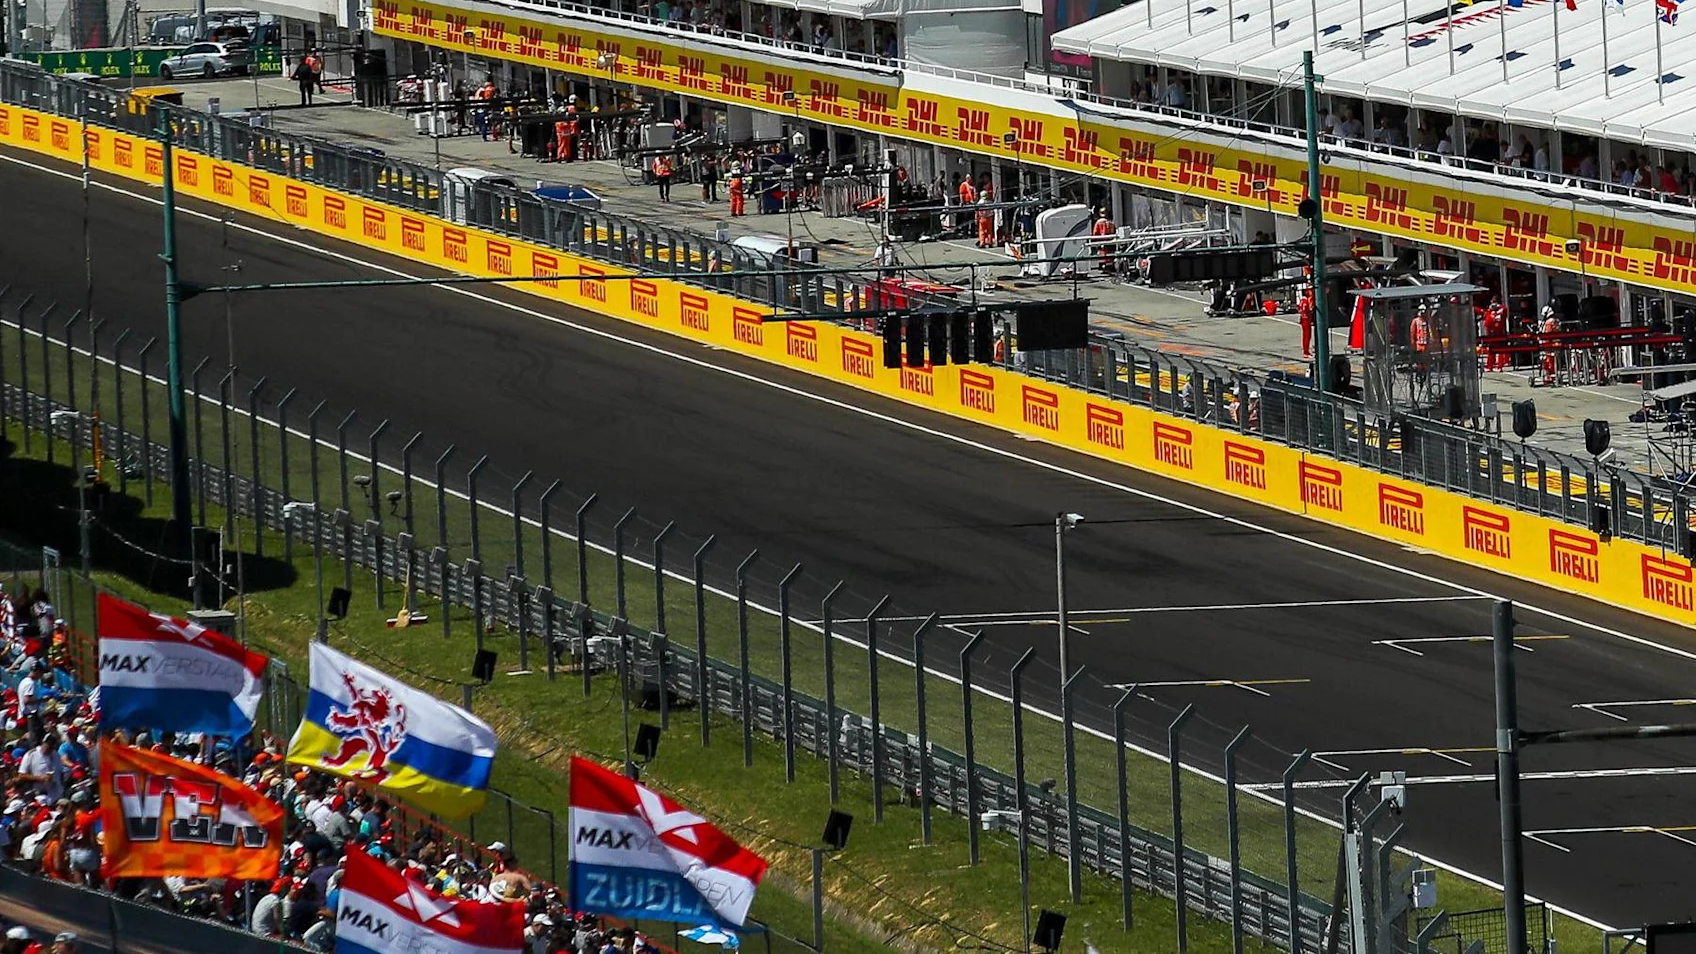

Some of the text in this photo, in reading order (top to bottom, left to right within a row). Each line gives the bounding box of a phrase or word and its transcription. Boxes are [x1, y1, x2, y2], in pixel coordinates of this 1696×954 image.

[377, 0, 398, 30] DHL
[412, 7, 432, 37] DHL
[481, 20, 505, 52] DHL
[518, 26, 544, 58] DHL
[557, 33, 581, 64] DHL
[260, 62, 281, 71] ROLEX
[636, 47, 664, 80] DHL
[678, 55, 705, 90] DHL
[721, 63, 748, 99] DHL
[810, 79, 840, 116] DHL
[858, 89, 888, 127] DHL
[908, 98, 940, 135] DHL
[958, 108, 992, 146] DHL
[1064, 127, 1100, 166] DHL
[1120, 137, 1158, 178] DHL
[1178, 148, 1218, 190] DHL
[364, 206, 386, 241] PIRELLI
[1366, 182, 1411, 227] DHL
[1433, 196, 1480, 242] DHL
[402, 217, 425, 251] PIRELLI
[443, 228, 467, 263] PIRELLI
[1504, 208, 1552, 256] DHL
[1577, 222, 1628, 272] DHL
[488, 240, 512, 276] PIRELLI
[631, 280, 658, 318] PIRELLI
[680, 293, 709, 332] PIRELLI
[733, 306, 763, 346] PIRELLI
[786, 321, 817, 362] PIRELLI
[842, 336, 874, 380] PIRELLI
[960, 369, 994, 413] PIRELLI
[1022, 384, 1058, 432] PIRELLI
[1088, 402, 1124, 450] PIRELLI
[1154, 422, 1193, 471] PIRELLI
[1224, 440, 1266, 492] PIRELLI
[1300, 460, 1342, 512] PIRELLI
[1379, 482, 1424, 536] PIRELLI
[1464, 504, 1510, 559] PIRELLI
[1550, 527, 1599, 584] PIRELLI
[1642, 552, 1693, 612] PIRELLI
[101, 653, 150, 673] MAX
[576, 826, 634, 850] MAX
[339, 906, 389, 939] MAX
